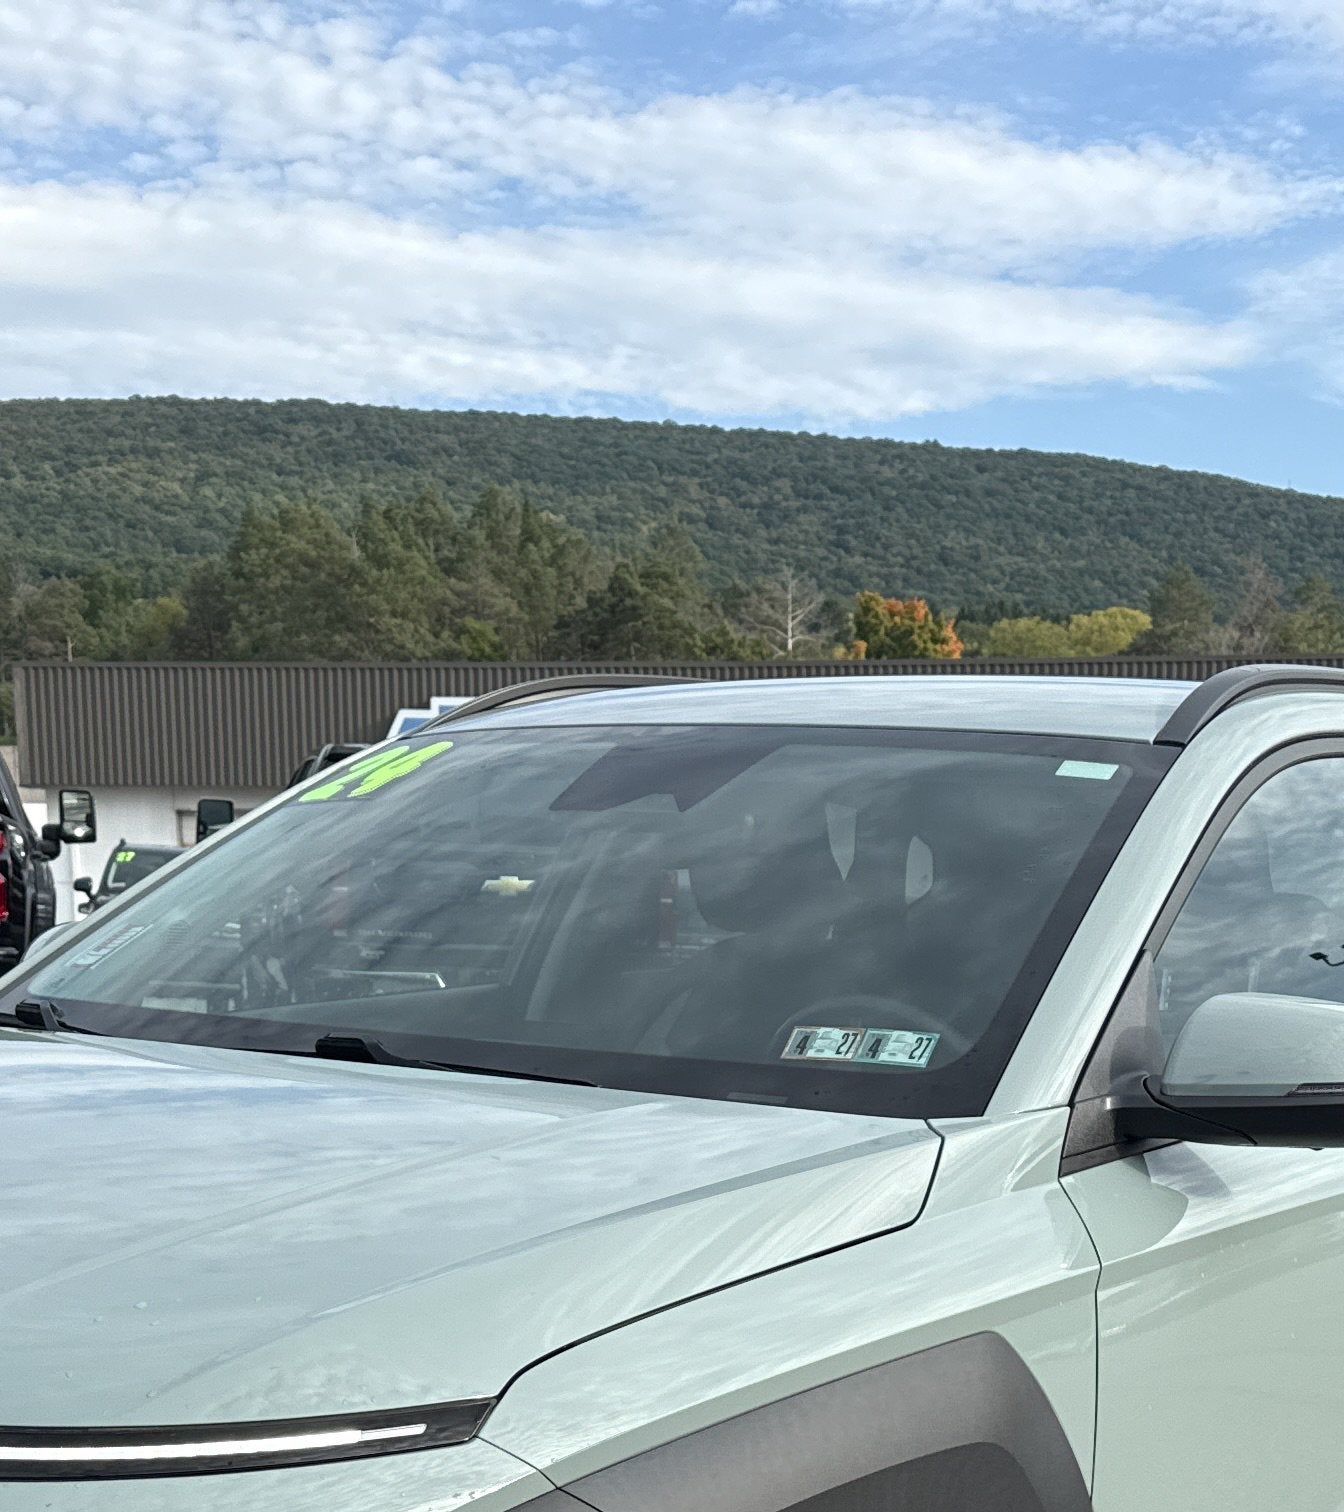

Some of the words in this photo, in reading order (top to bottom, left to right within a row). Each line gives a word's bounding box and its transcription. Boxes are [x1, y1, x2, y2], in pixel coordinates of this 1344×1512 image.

[796, 1035, 811, 1055] 4
[834, 1032, 859, 1057] 27
[867, 1037, 883, 1059] 4
[908, 1036, 933, 1062] 27
